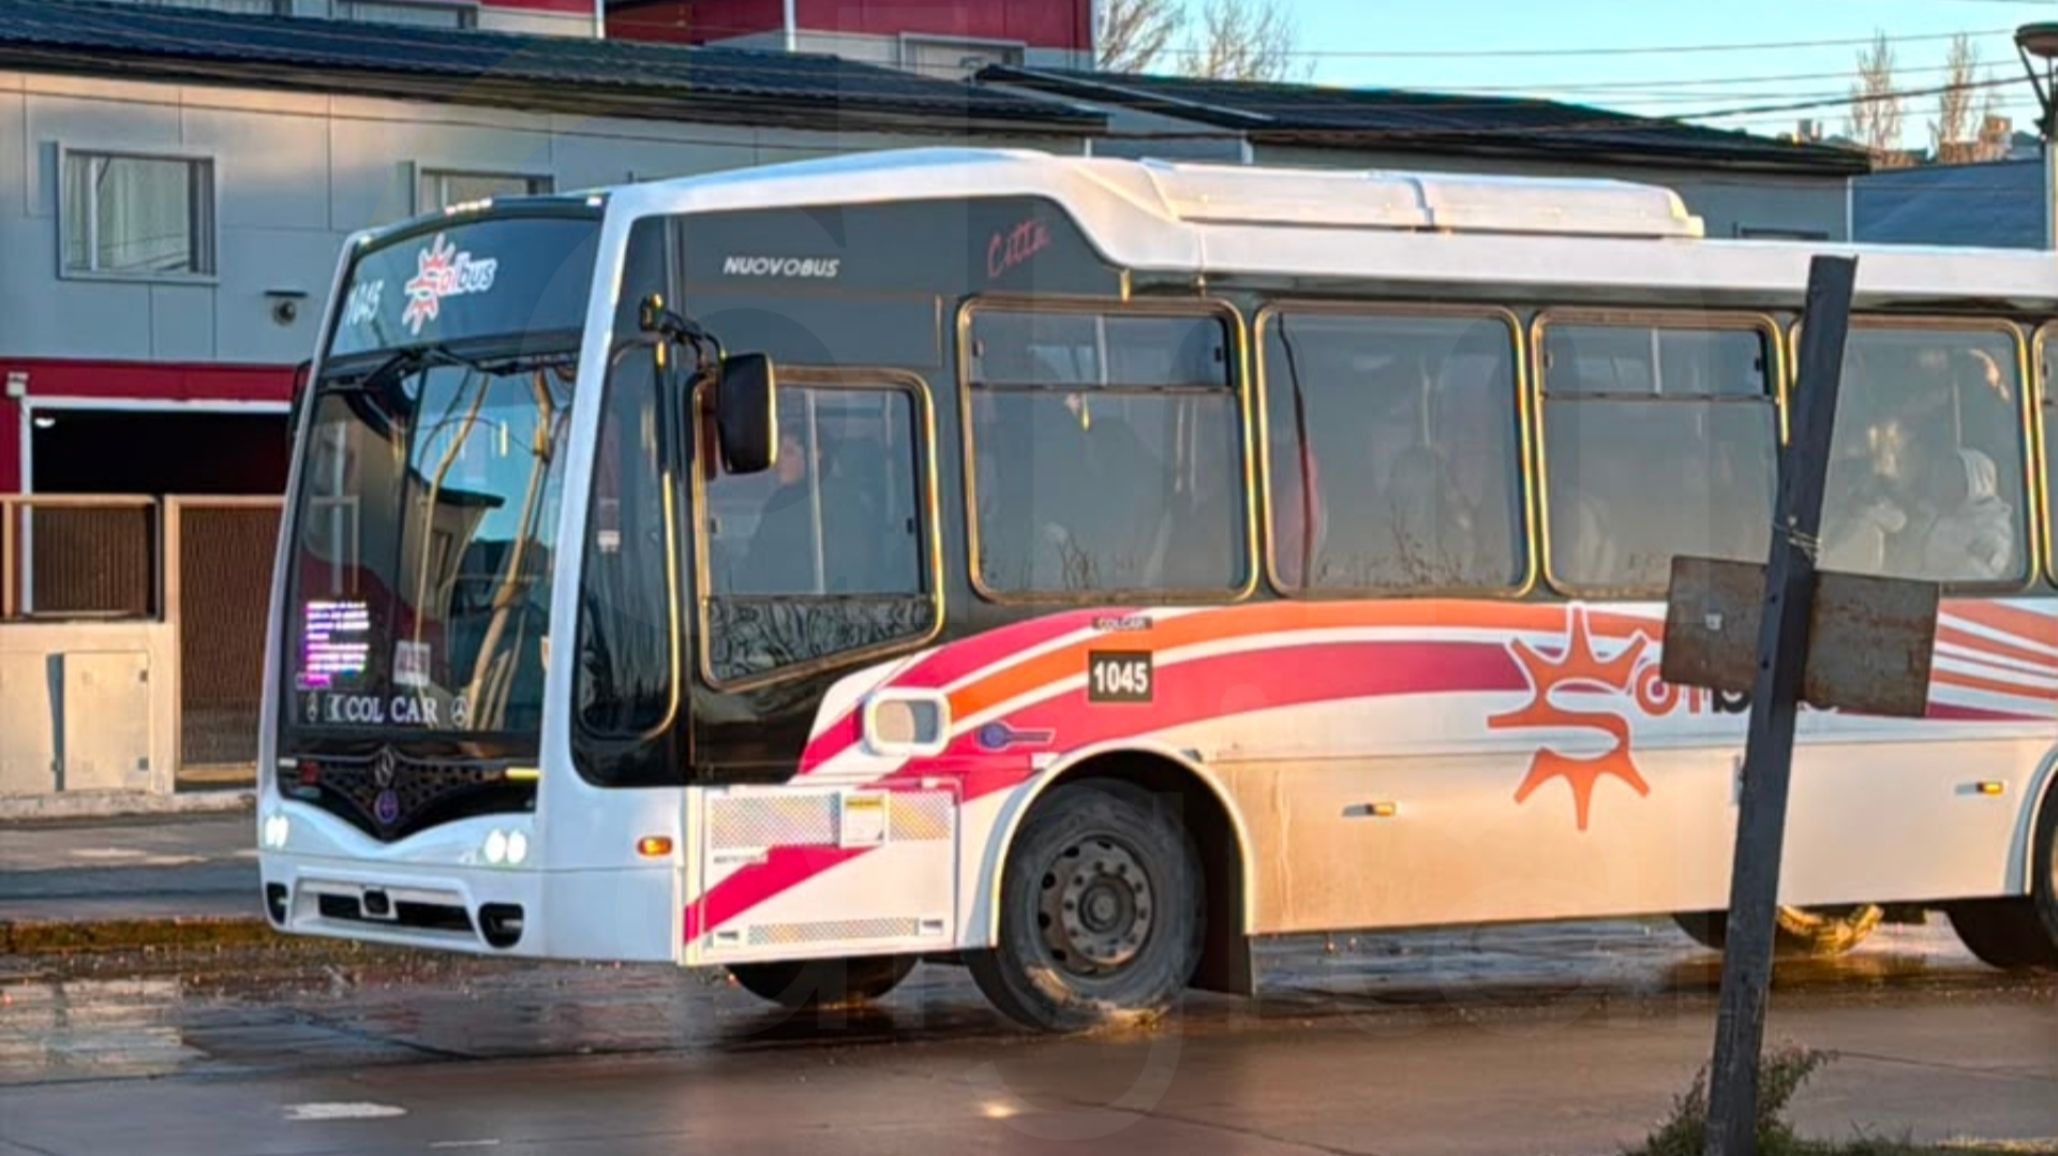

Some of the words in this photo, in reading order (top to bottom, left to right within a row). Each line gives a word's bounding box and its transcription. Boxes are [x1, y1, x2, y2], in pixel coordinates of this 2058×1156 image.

[723, 256, 841, 279] NUOVOBUS
[1094, 661, 1149, 694] 1045
[347, 696, 384, 722] COL
[391, 697, 437, 723] CAR
